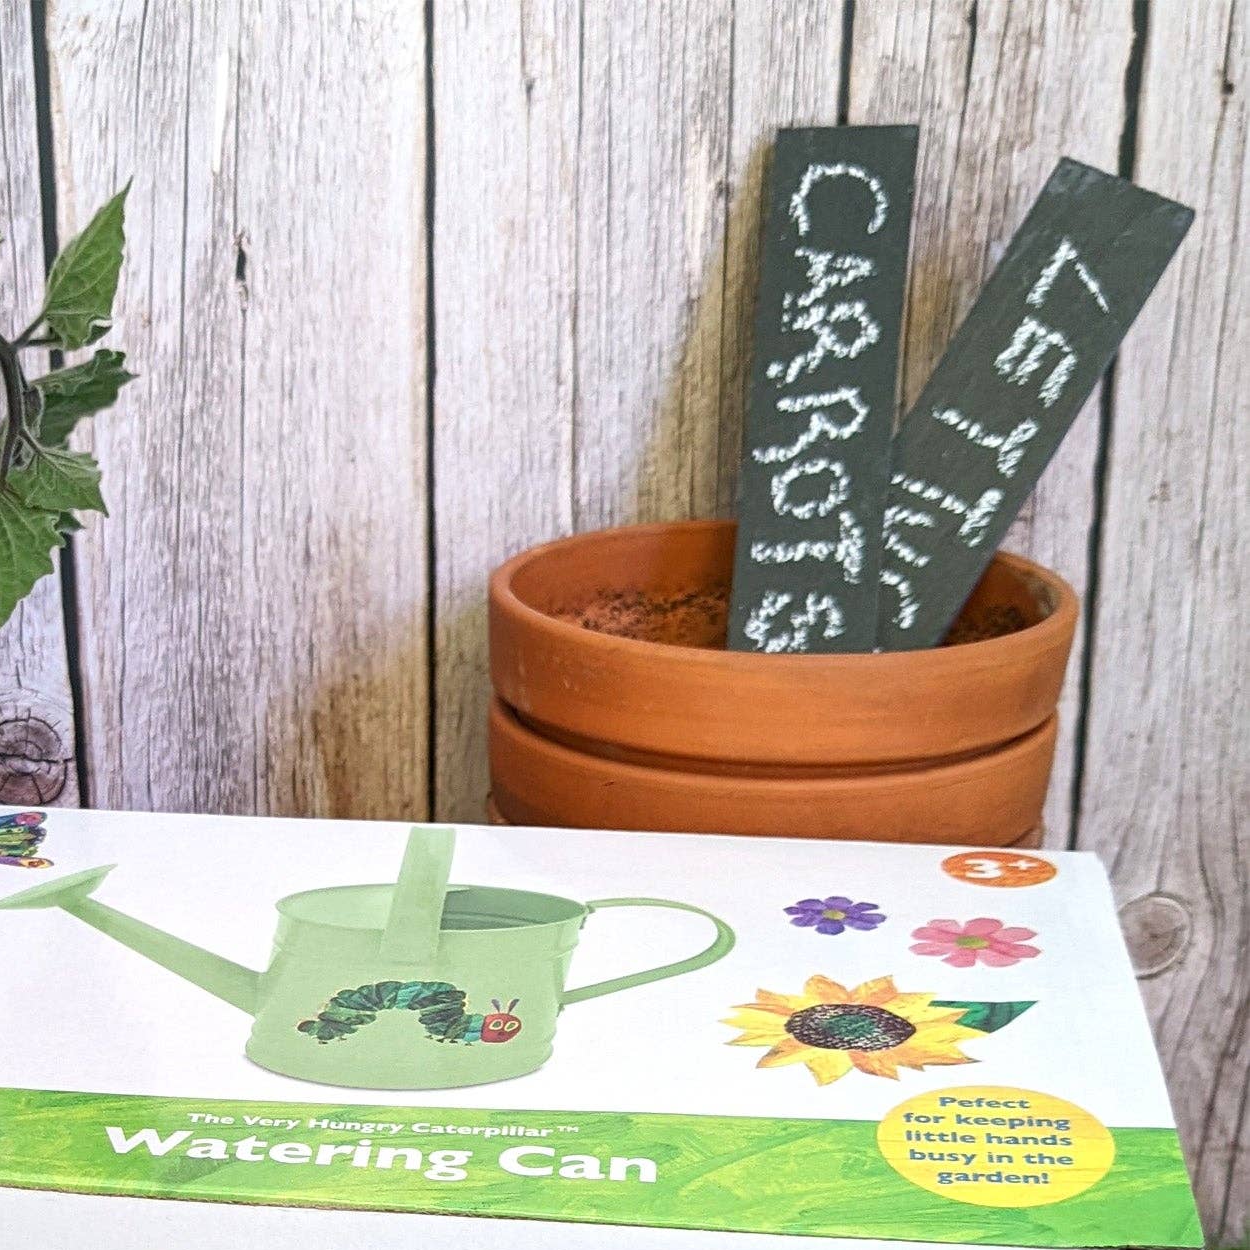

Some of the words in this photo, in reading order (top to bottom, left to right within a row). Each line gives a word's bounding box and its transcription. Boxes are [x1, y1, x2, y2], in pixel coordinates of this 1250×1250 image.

[745, 161, 889, 654] CARROTS
[964, 858, 1039, 879] 3+
[938, 1096, 1031, 1109] Pefect
[187, 1112, 235, 1128] The
[241, 1115, 301, 1131] Very
[308, 1117, 403, 1136] Hungry
[903, 1112, 945, 1124] for
[955, 1114, 1071, 1131] keeping
[905, 1131, 976, 1144] little
[985, 1132, 1073, 1147] hands
[104, 1126, 473, 1182] Watering
[498, 1145, 658, 1183] Can
[909, 1149, 977, 1166] busy
[987, 1151, 1014, 1164] in
[1024, 1153, 1074, 1166] the
[937, 1171, 1050, 1185] garden!
